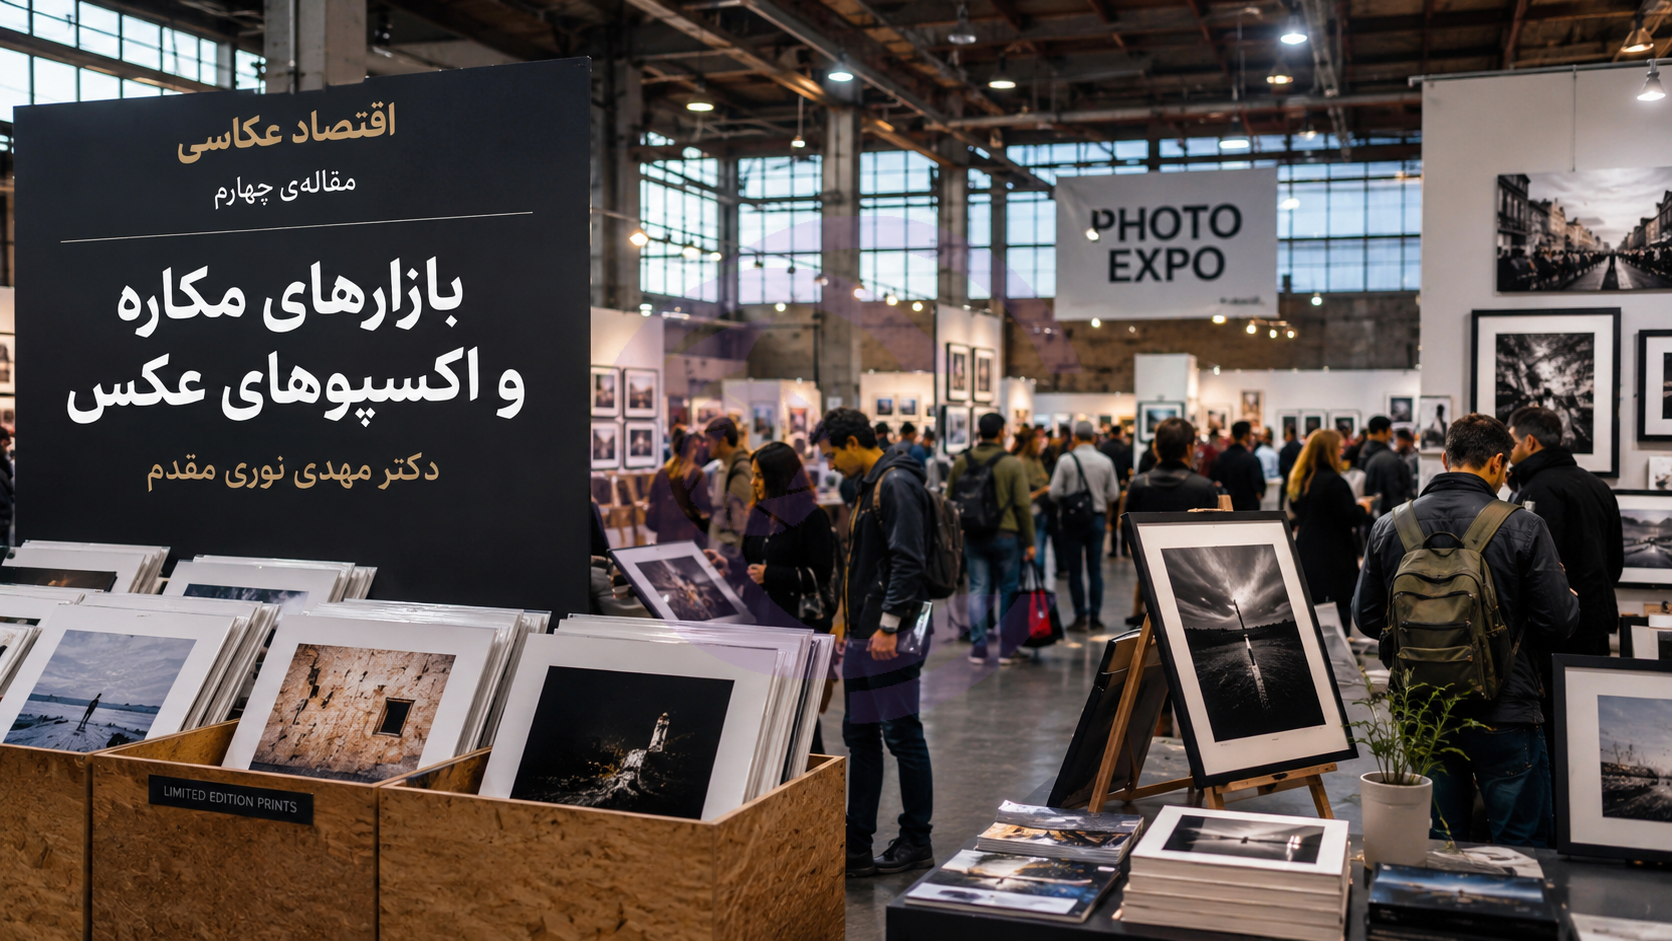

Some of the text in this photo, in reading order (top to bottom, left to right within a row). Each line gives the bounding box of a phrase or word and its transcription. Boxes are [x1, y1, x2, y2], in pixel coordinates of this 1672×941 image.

[177, 100, 397, 164] اقتصاد عکاسی
[214, 175, 274, 210] چهارم
[1090, 203, 1243, 243] PHOTO
[1108, 245, 1226, 284] EXPO
[117, 255, 464, 339] بازارهای مکاره
[66, 345, 526, 428] و اکسپوهای عکس
[147, 451, 440, 493] دکتر مهدی نوری مقدم
[163, 785, 298, 813] LIMITED EDITION PRINTS
